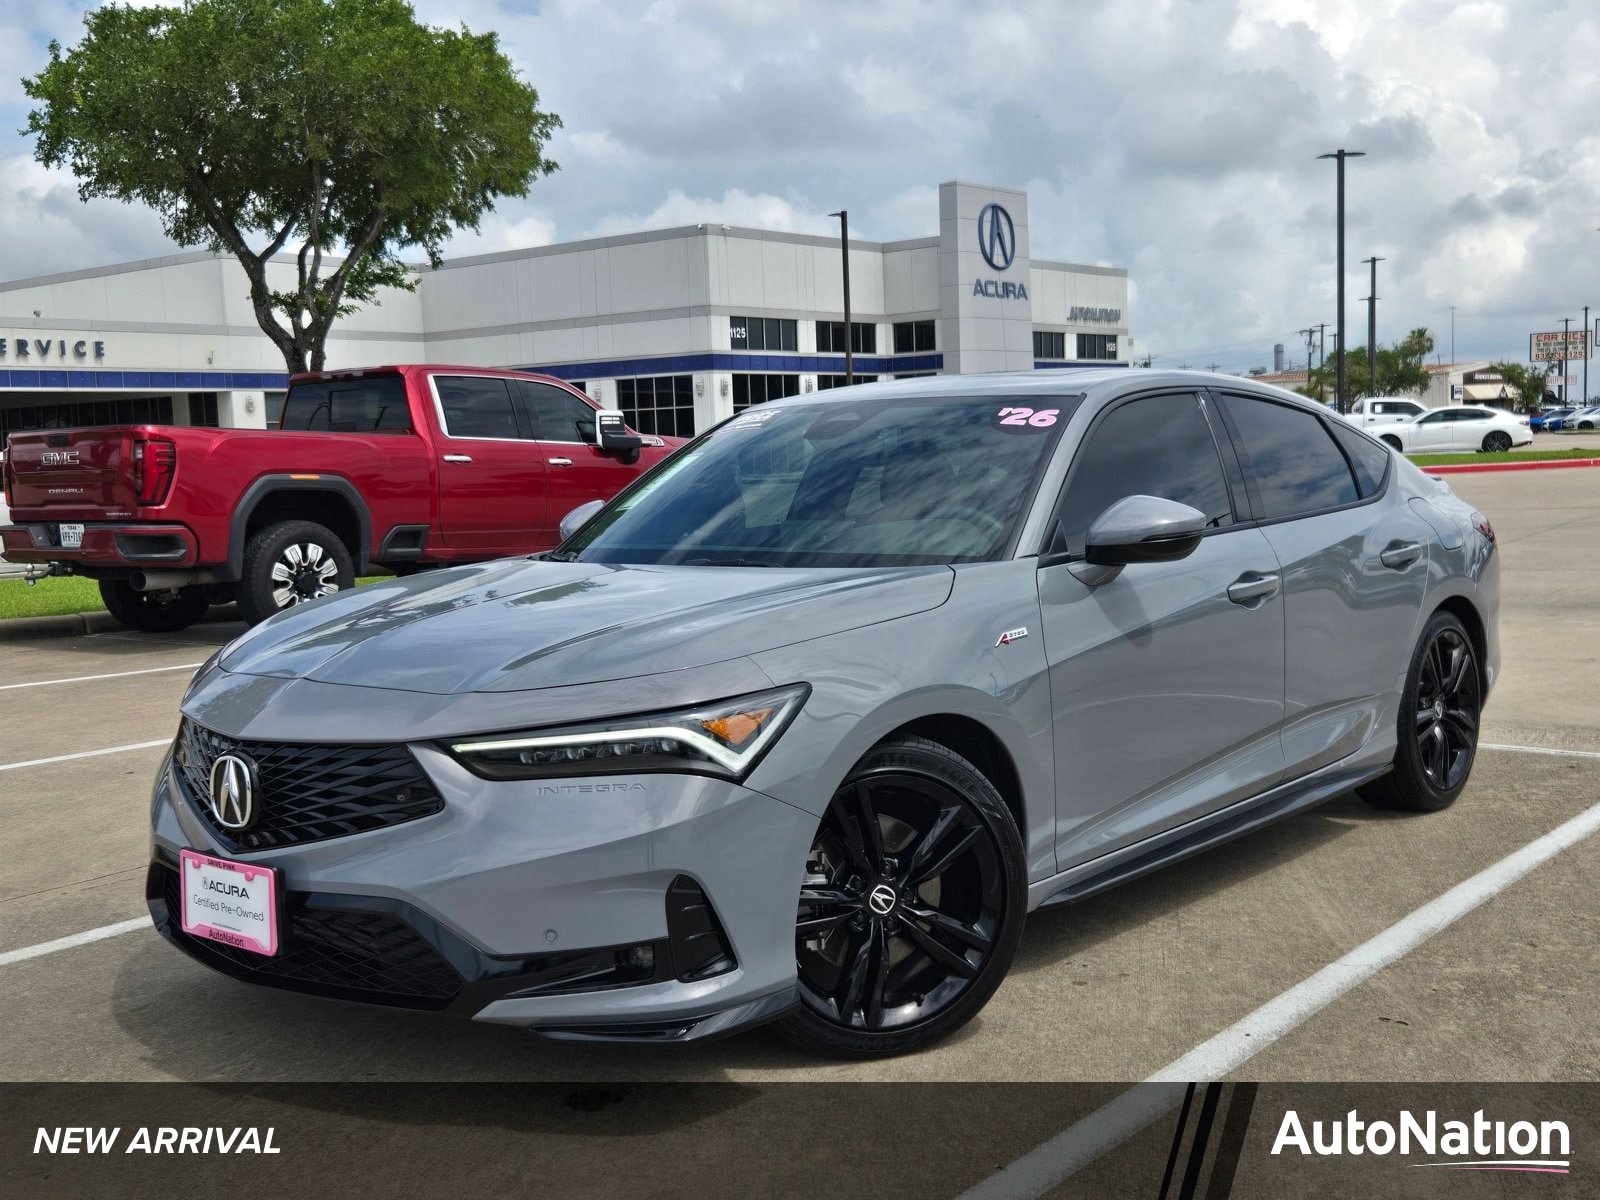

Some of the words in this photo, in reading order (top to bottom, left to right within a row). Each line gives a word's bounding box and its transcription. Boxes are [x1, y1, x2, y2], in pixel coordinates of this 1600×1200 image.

[973, 279, 1028, 300] ACURA
[730, 327, 746, 339] 1125
[998, 408, 1059, 427] '26
[41, 451, 79, 466] GMC
[536, 783, 646, 796] INTEGRA
[207, 858, 222, 869] DRIVE
[222, 862, 236, 871] PINK
[208, 880, 250, 899] ACURA
[193, 894, 219, 911] Certified
[221, 902, 264, 921] Pre-Owned
[208, 928, 244, 947] AutoNation
